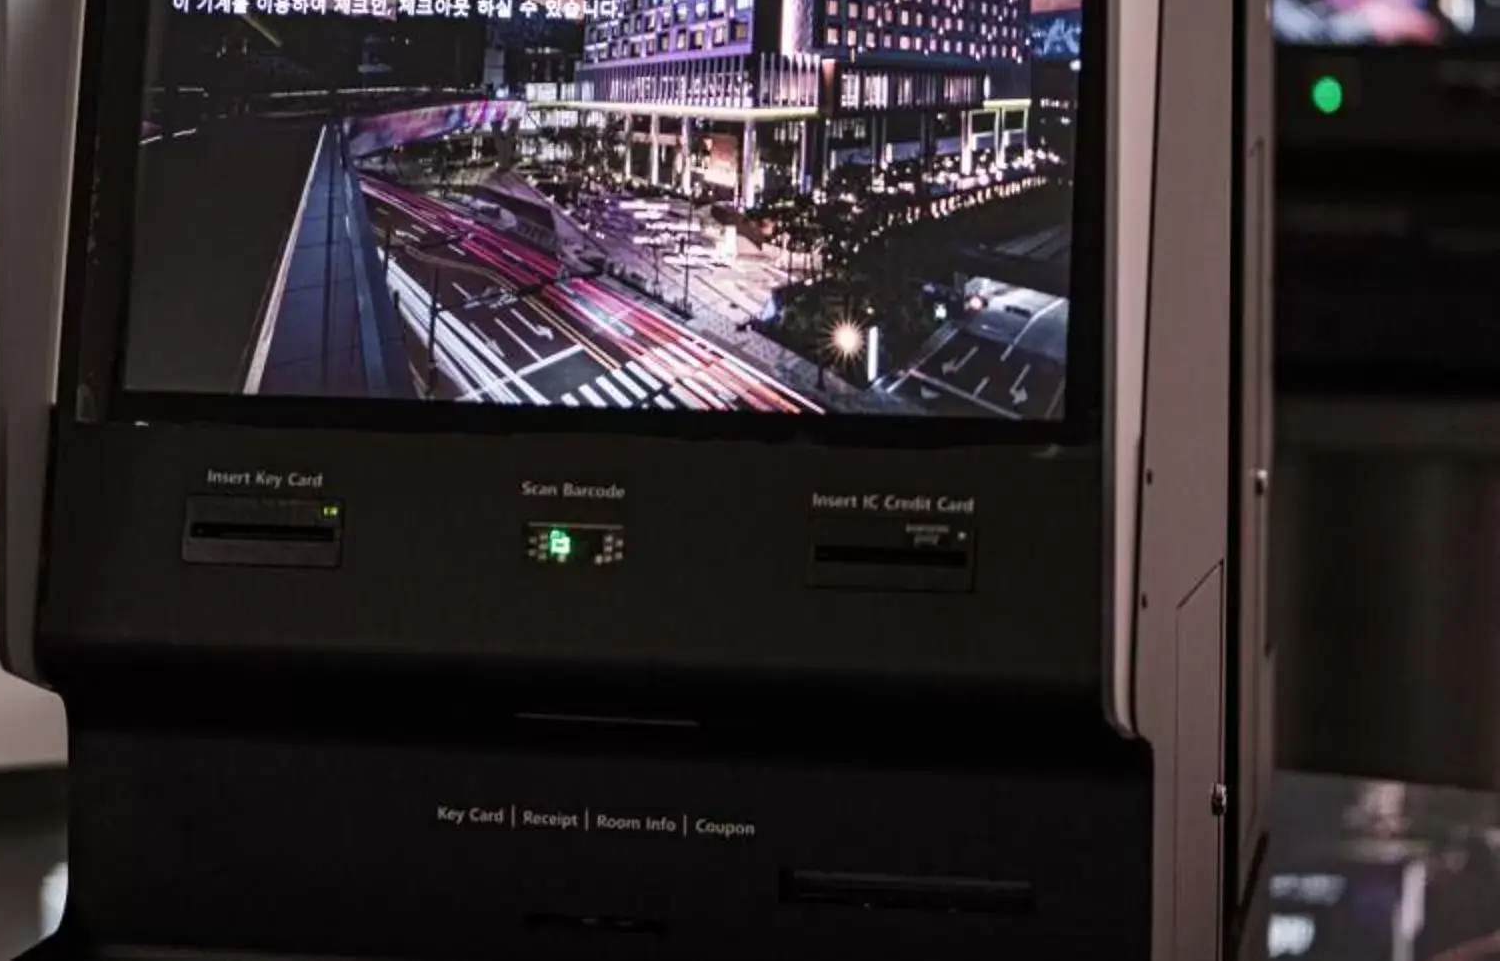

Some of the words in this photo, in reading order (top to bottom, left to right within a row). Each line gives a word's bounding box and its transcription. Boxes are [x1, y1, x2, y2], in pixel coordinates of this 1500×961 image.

[207, 468, 250, 485] Insert
[255, 470, 283, 488] Key
[288, 472, 323, 488] Card
[521, 481, 558, 496] Scan
[563, 482, 625, 499] Barcode
[812, 492, 858, 509] Insert
[863, 495, 879, 510] IC
[884, 495, 931, 511] Credit
[937, 497, 975, 513] Card
[437, 806, 465, 822] Key
[469, 807, 504, 823] Card
[523, 810, 579, 828] Receipt
[597, 814, 641, 830] Room
[645, 816, 677, 831] Info
[695, 818, 756, 836] Coupon
